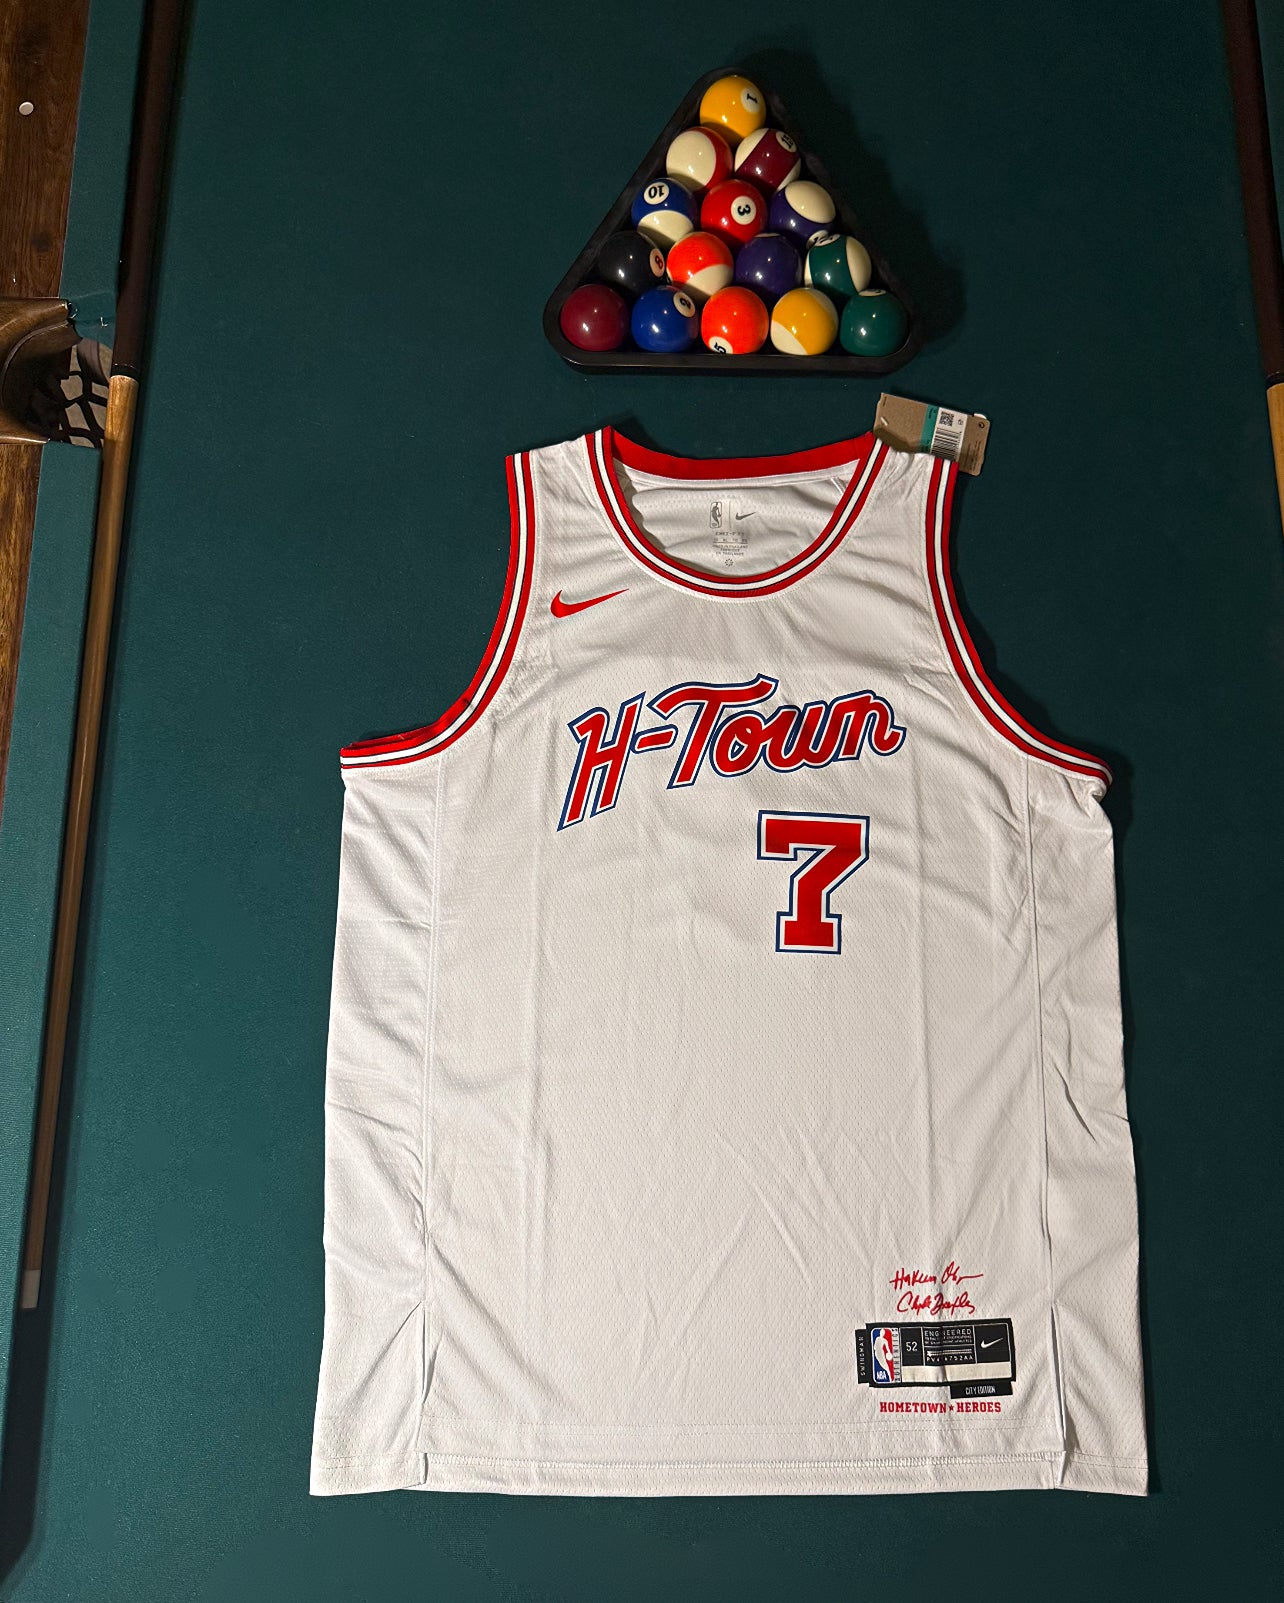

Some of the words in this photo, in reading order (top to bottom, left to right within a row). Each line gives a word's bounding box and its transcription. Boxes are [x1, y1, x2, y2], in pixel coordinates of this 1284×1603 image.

[747, 93, 758, 104] 1
[648, 184, 665, 199] 10
[737, 204, 751, 216] 3
[654, 254, 664, 270] 8
[557, 673, 907, 832] H-Town
[757, 810, 870, 955] 7
[924, 1328, 972, 1337] ENGEERED
[905, 1341, 918, 1352] 52
[891, 1328, 901, 1383] AUTHENTICS
[876, 1370, 887, 1380] NBA
[965, 1386, 977, 1395] CITY
[879, 1401, 947, 1414] HOMETOWN
[956, 1401, 1002, 1413] HEROES
